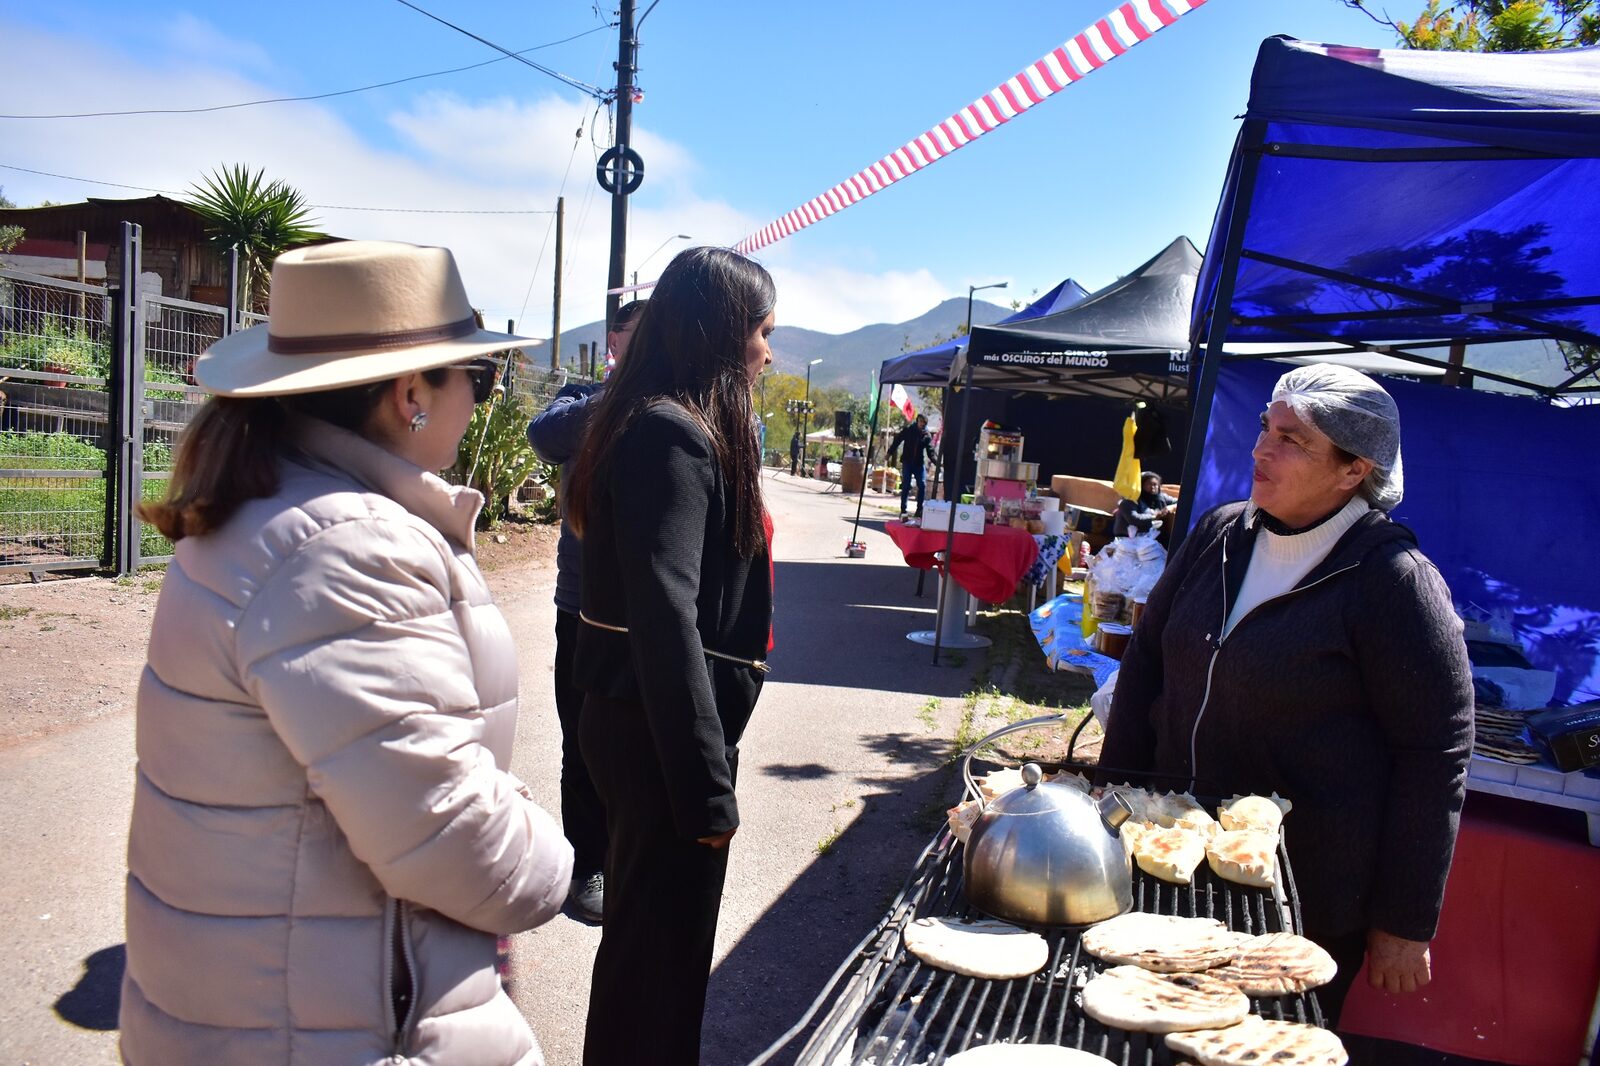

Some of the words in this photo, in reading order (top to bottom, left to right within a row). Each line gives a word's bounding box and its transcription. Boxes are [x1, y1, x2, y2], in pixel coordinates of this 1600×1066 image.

[983, 353, 1000, 361] más
[1001, 353, 1045, 364] OSCUROS
[1046, 354, 1064, 365] del
[1065, 356, 1109, 367] MUNDO
